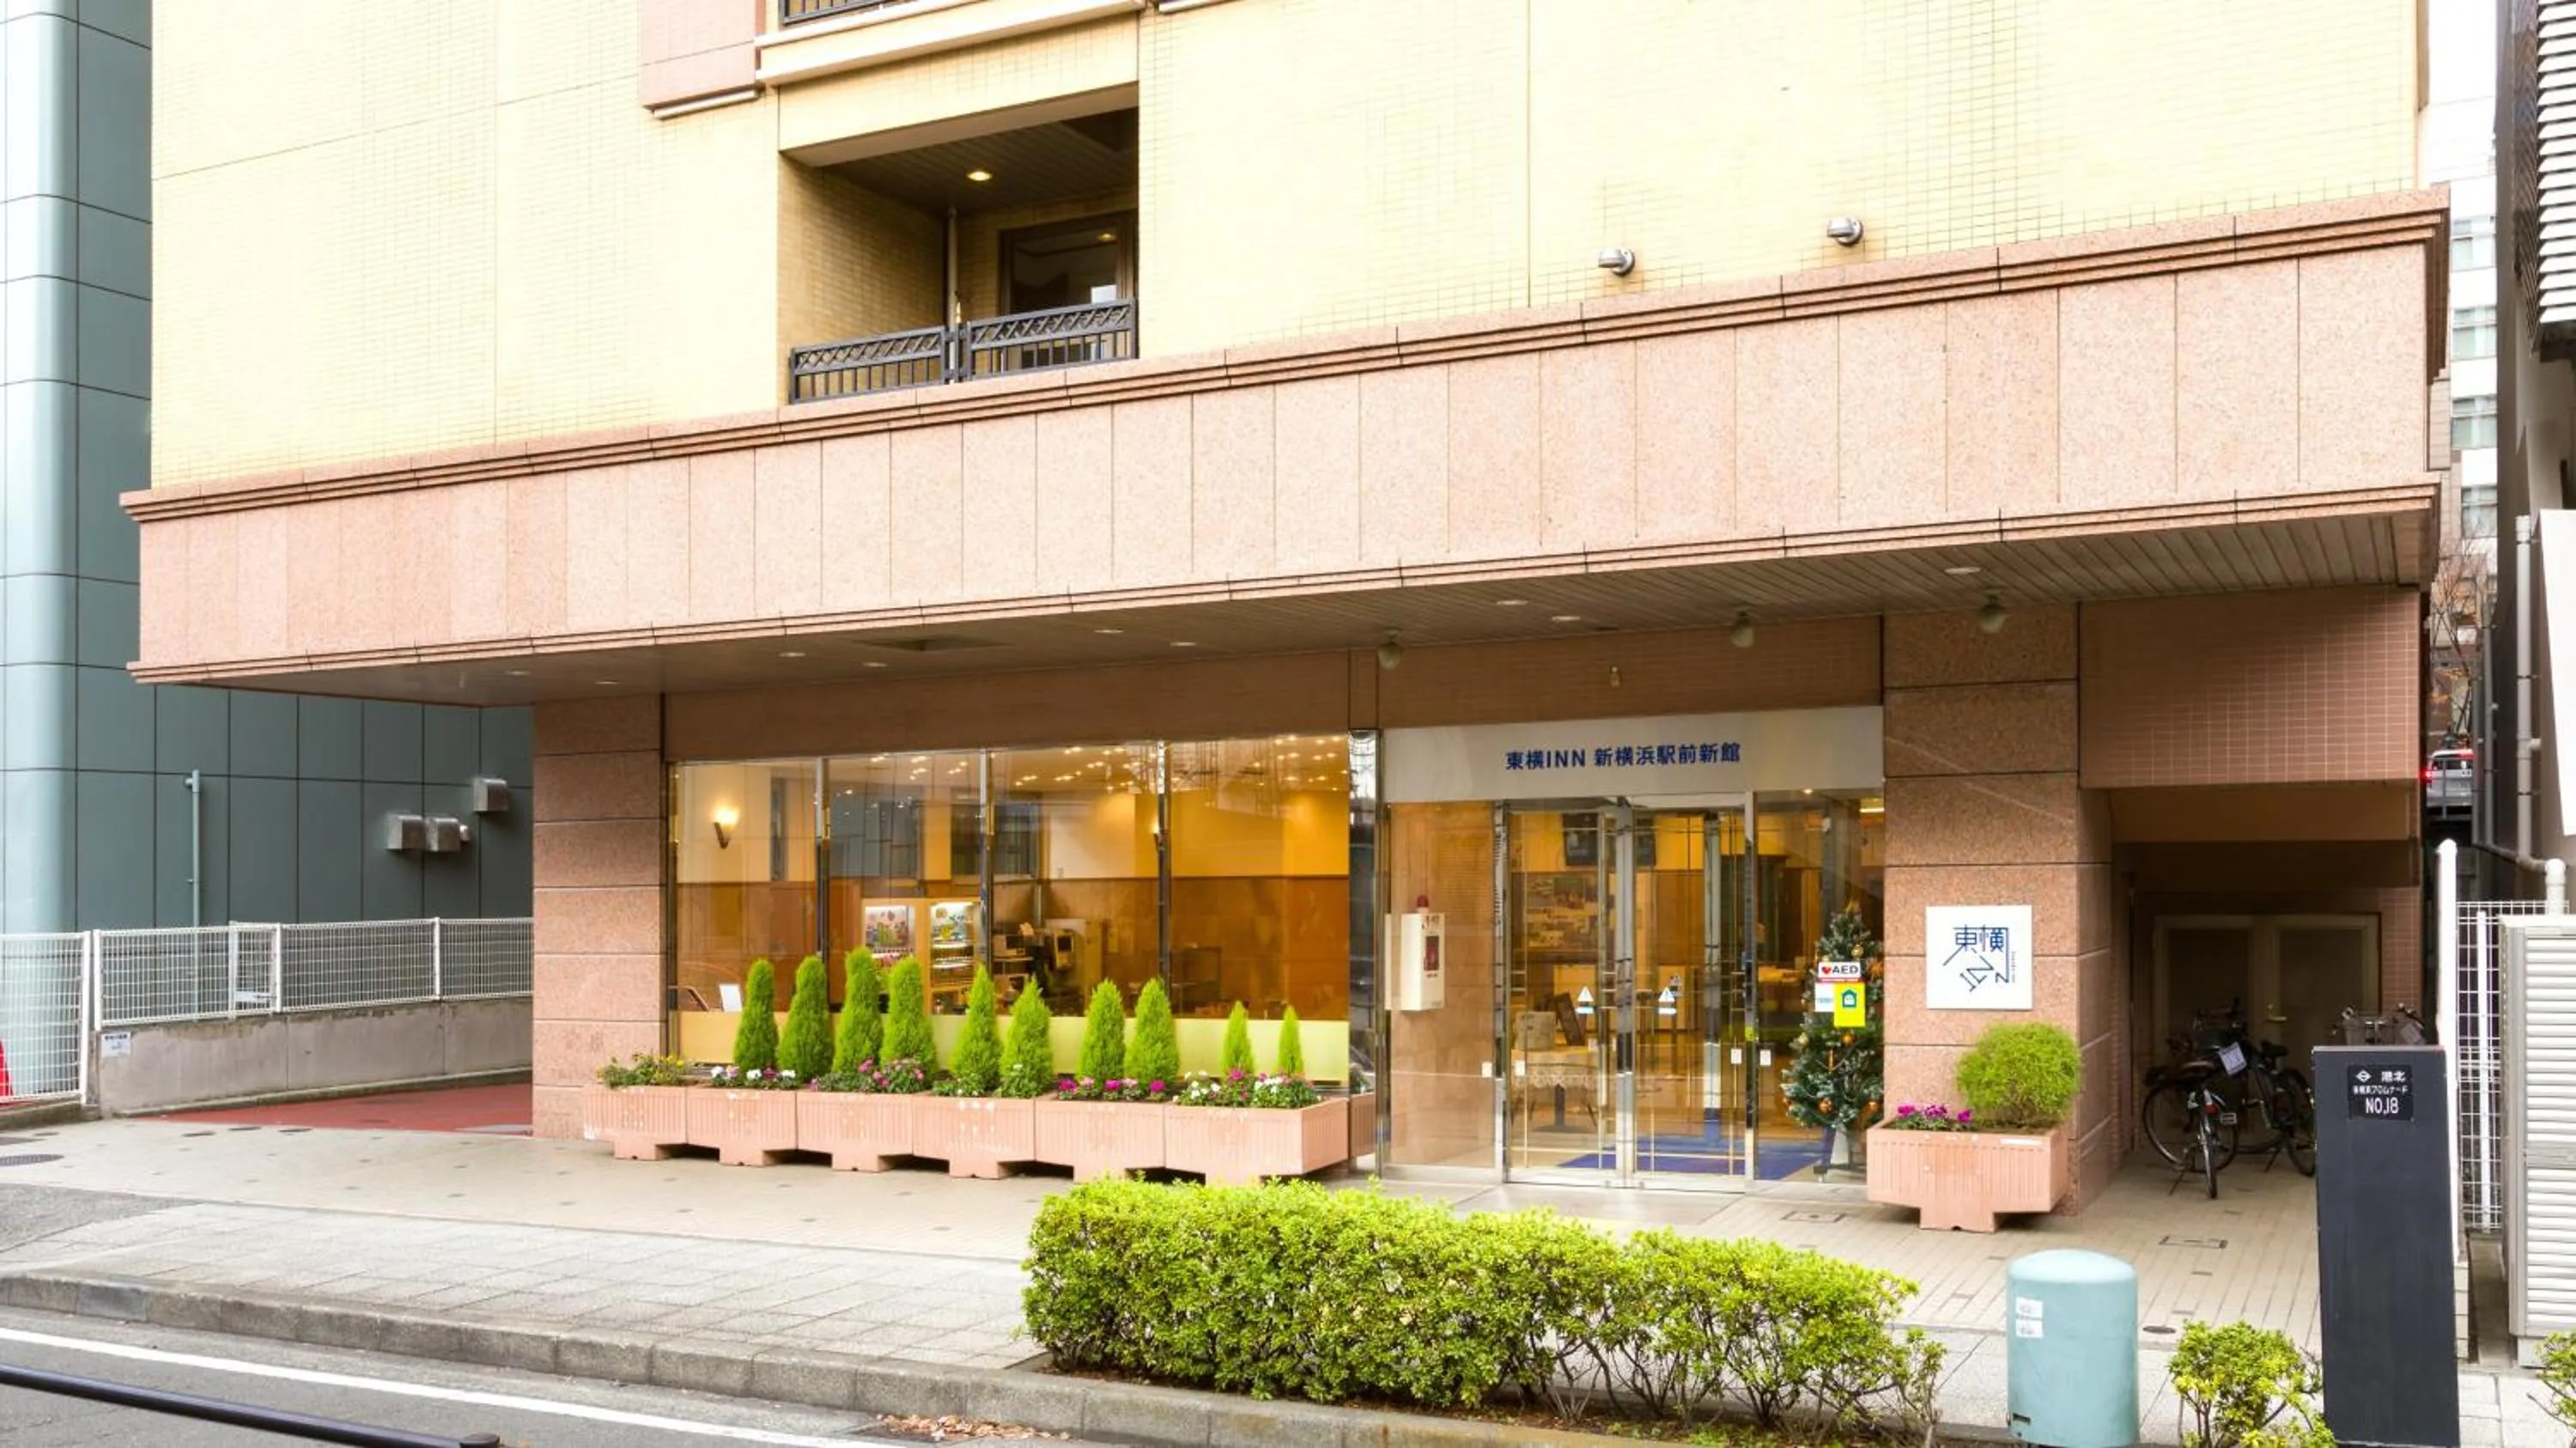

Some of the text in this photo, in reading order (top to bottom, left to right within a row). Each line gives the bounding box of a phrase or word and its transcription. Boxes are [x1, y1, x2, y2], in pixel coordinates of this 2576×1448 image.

[1505, 741, 1741, 770] 東横INN 新横浜駅前新館
[1832, 964, 1859, 975] AED
